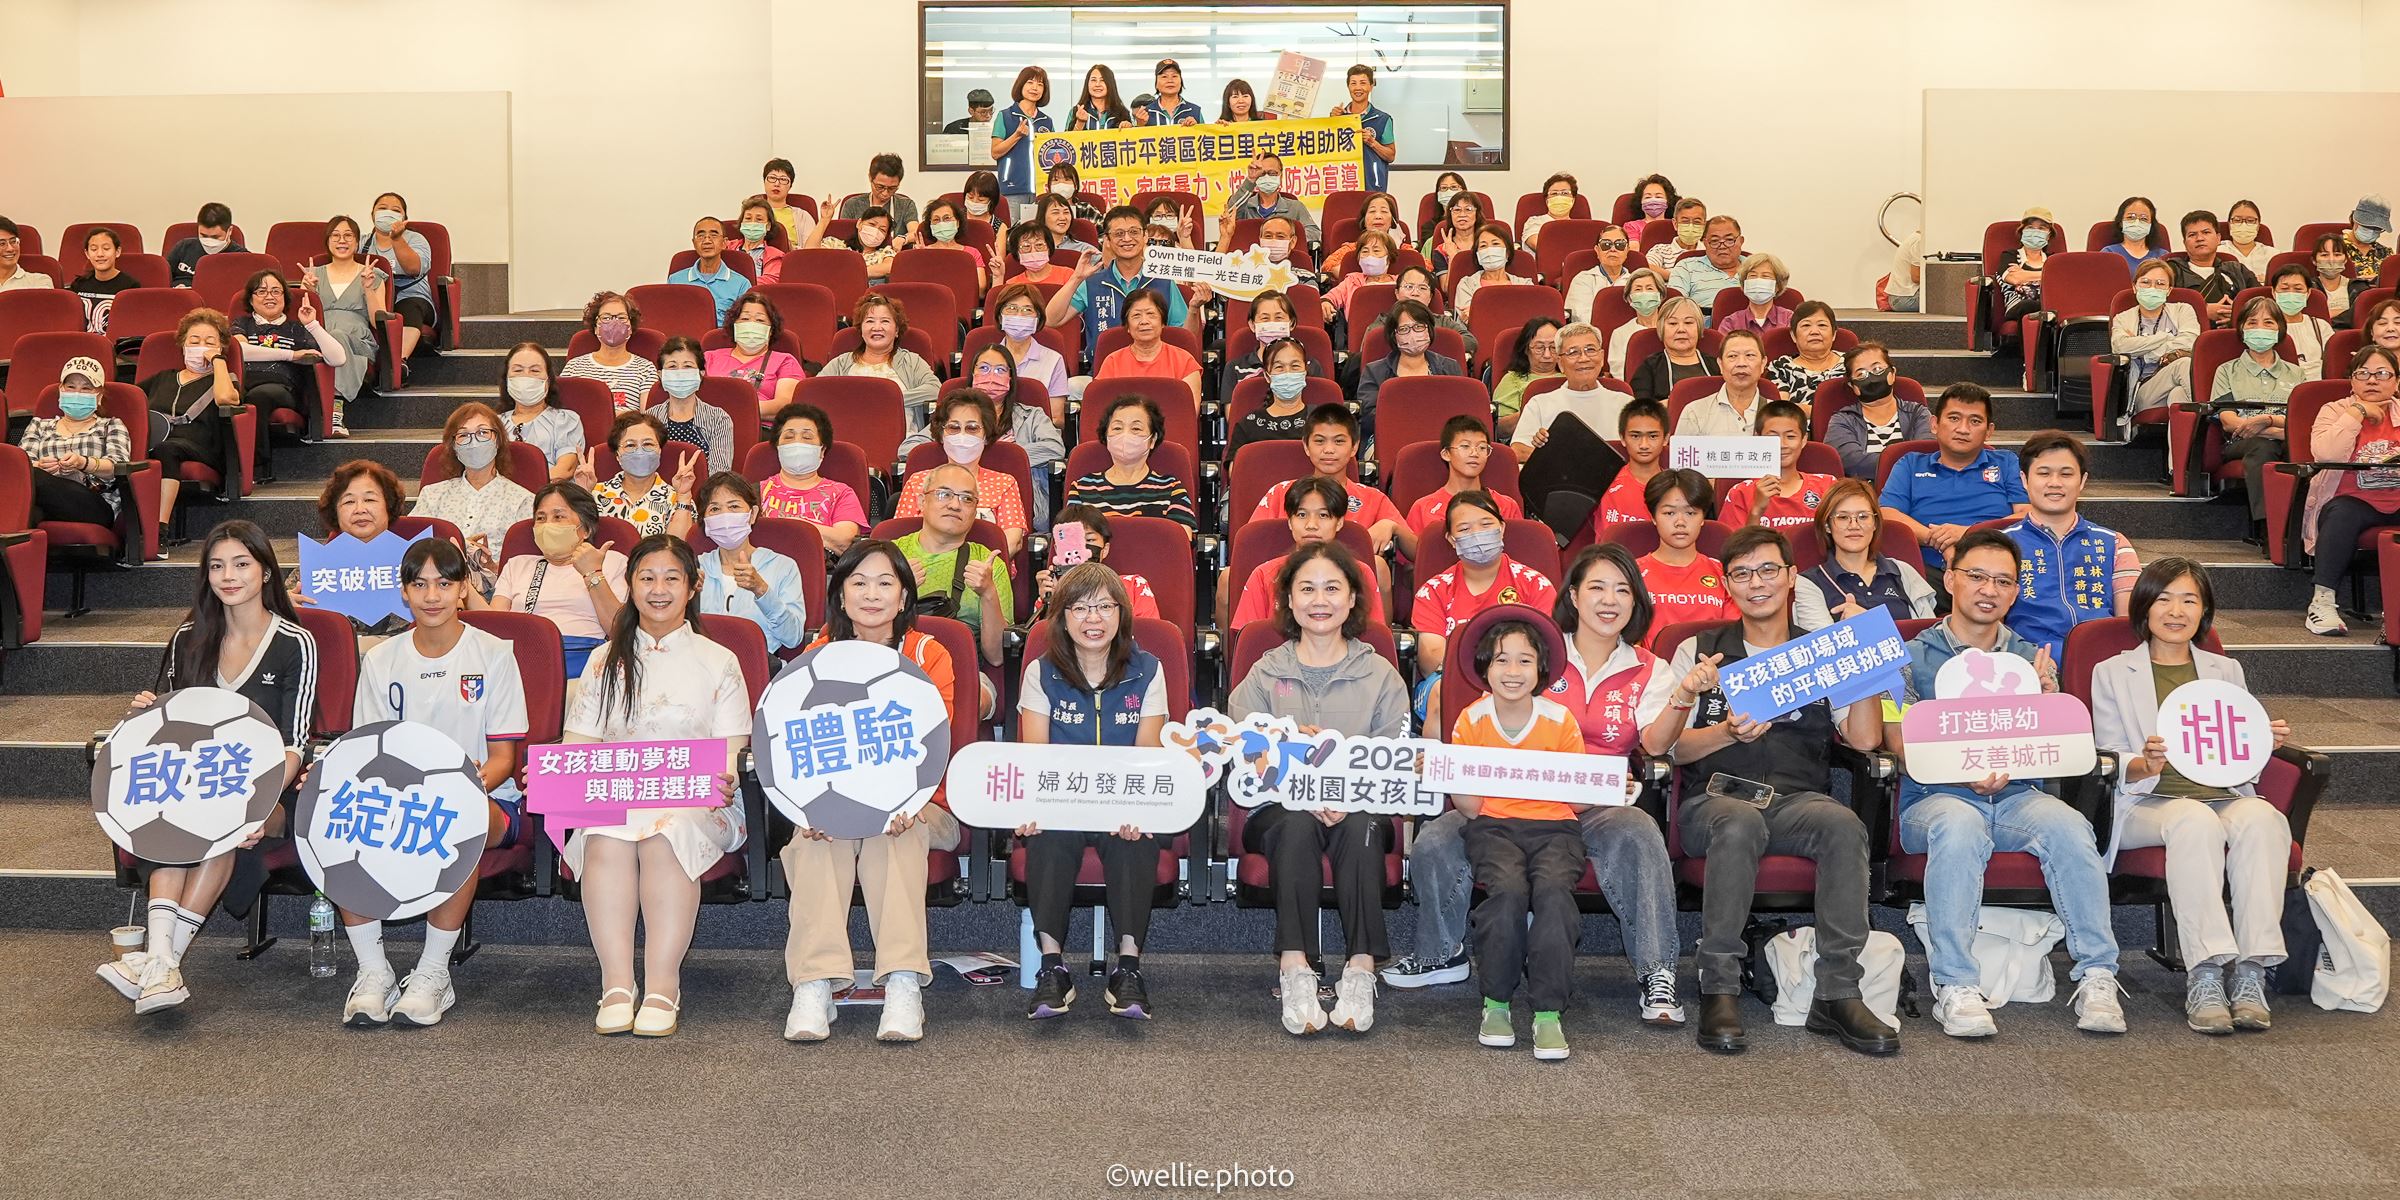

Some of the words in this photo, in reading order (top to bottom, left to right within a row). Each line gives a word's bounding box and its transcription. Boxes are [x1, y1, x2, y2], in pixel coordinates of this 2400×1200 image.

[1080, 127, 1356, 169] 桃園市平鎮區復旦里守望相助隊
[1149, 249, 1174, 261] Own
[1177, 252, 1195, 262] the
[1197, 254, 1223, 265] Field
[1706, 451, 1773, 462] 桃園市政府
[1658, 593, 1723, 608] TAOYUAN
[420, 671, 447, 679] ENTES
[1725, 625, 1859, 697] 女孩運動場域
[1771, 637, 1905, 707] 的平權與挑戰
[389, 681, 404, 721] 9
[1939, 706, 2039, 735] 打造婦幼
[785, 700, 919, 780] 體驗
[538, 746, 690, 775] 女孩運動夢想
[1961, 743, 2061, 771] 友善城市
[124, 742, 252, 806] 啟發
[1037, 770, 1174, 796] 婦幼發展局
[1461, 763, 1620, 787] 桃園市政府婦幼發展局
[584, 775, 712, 803] 與職涯選擇
[325, 780, 458, 860] 綻放
